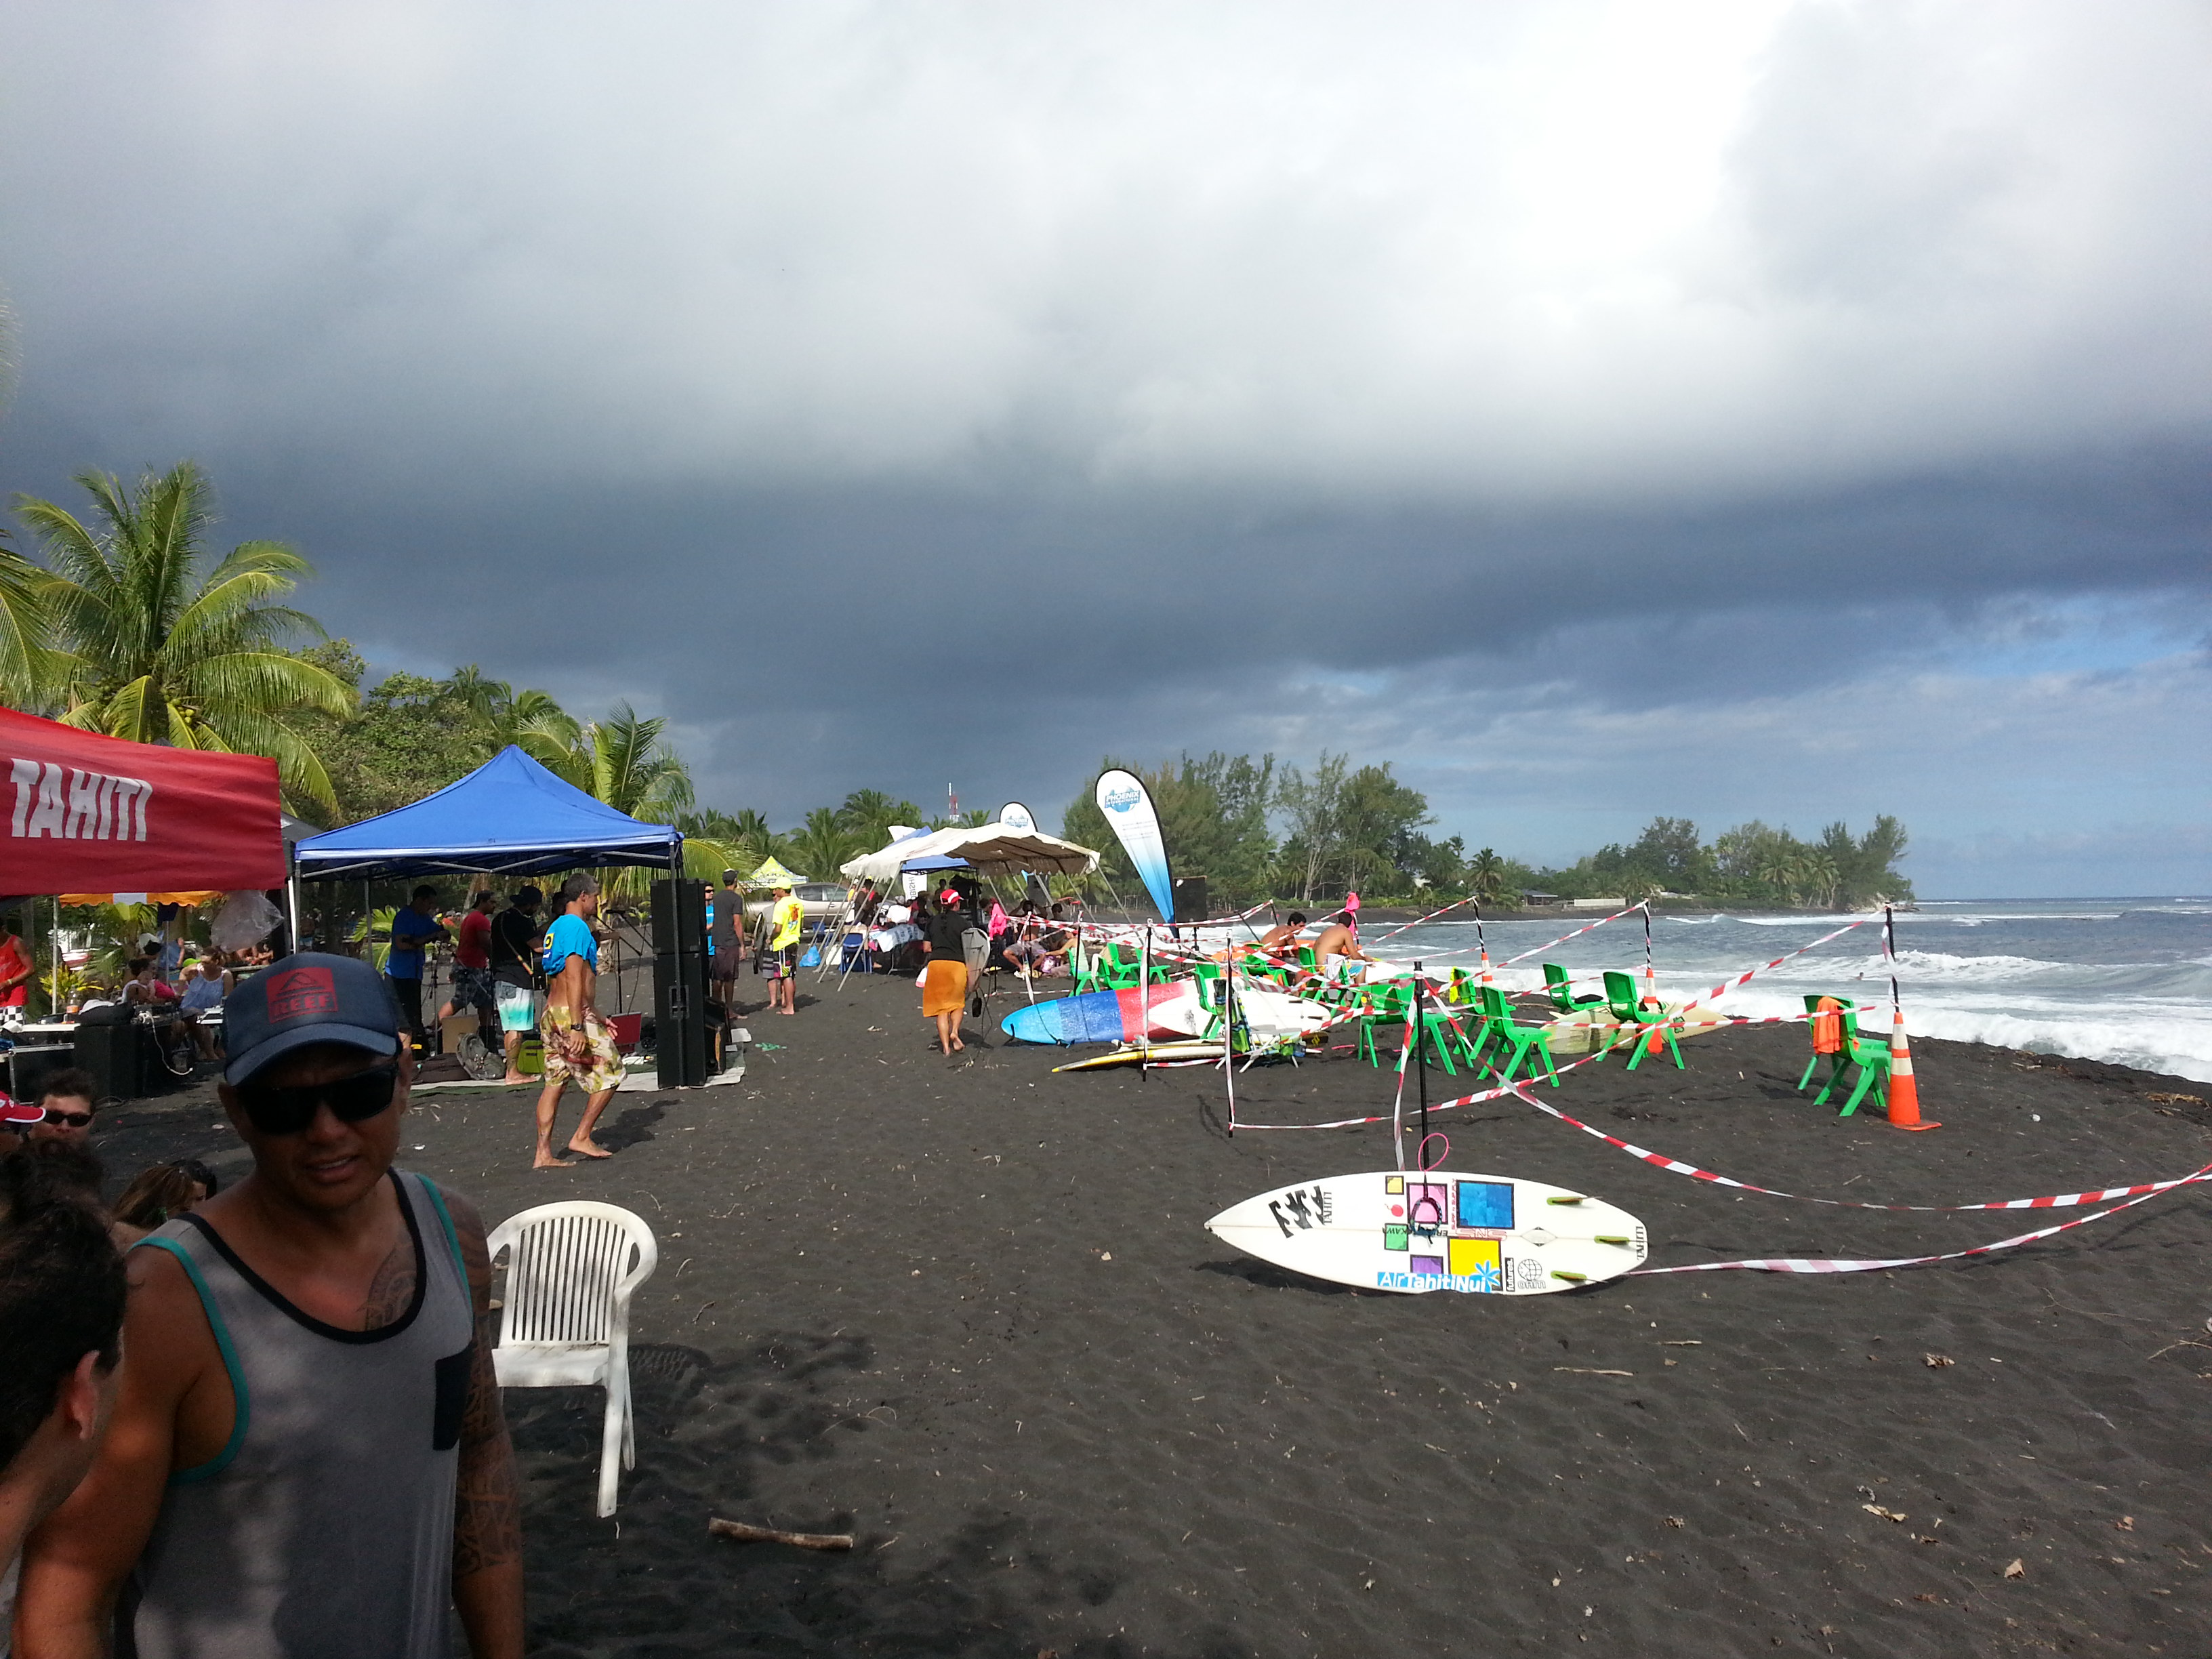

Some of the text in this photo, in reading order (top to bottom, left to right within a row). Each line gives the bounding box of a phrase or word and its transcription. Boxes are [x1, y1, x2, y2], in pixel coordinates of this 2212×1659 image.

[10, 758, 153, 841] TAHITI
[1106, 791, 1139, 802] PHOENIX
[274, 994, 331, 1016] REEF
[1324, 1192, 1332, 1223] TAHITI
[1635, 1225, 1645, 1261] TAHITI
